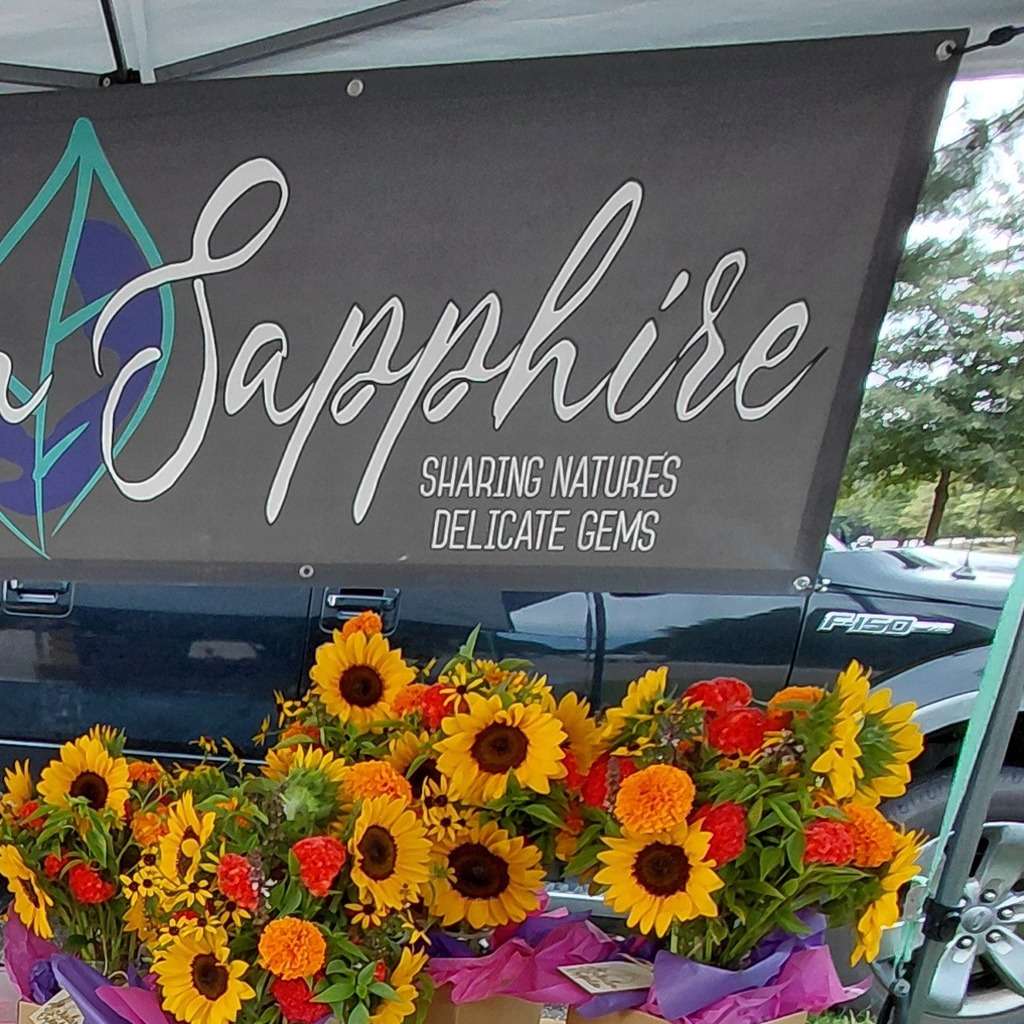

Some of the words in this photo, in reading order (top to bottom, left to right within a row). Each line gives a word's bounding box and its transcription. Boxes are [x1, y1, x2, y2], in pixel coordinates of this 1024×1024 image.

[94, 157, 829, 523] Sapphire
[419, 455, 544, 498] SHARING
[430, 508, 571, 551] DELICATE
[576, 509, 660, 551] GEMS
[816, 611, 918, 637] F-150
